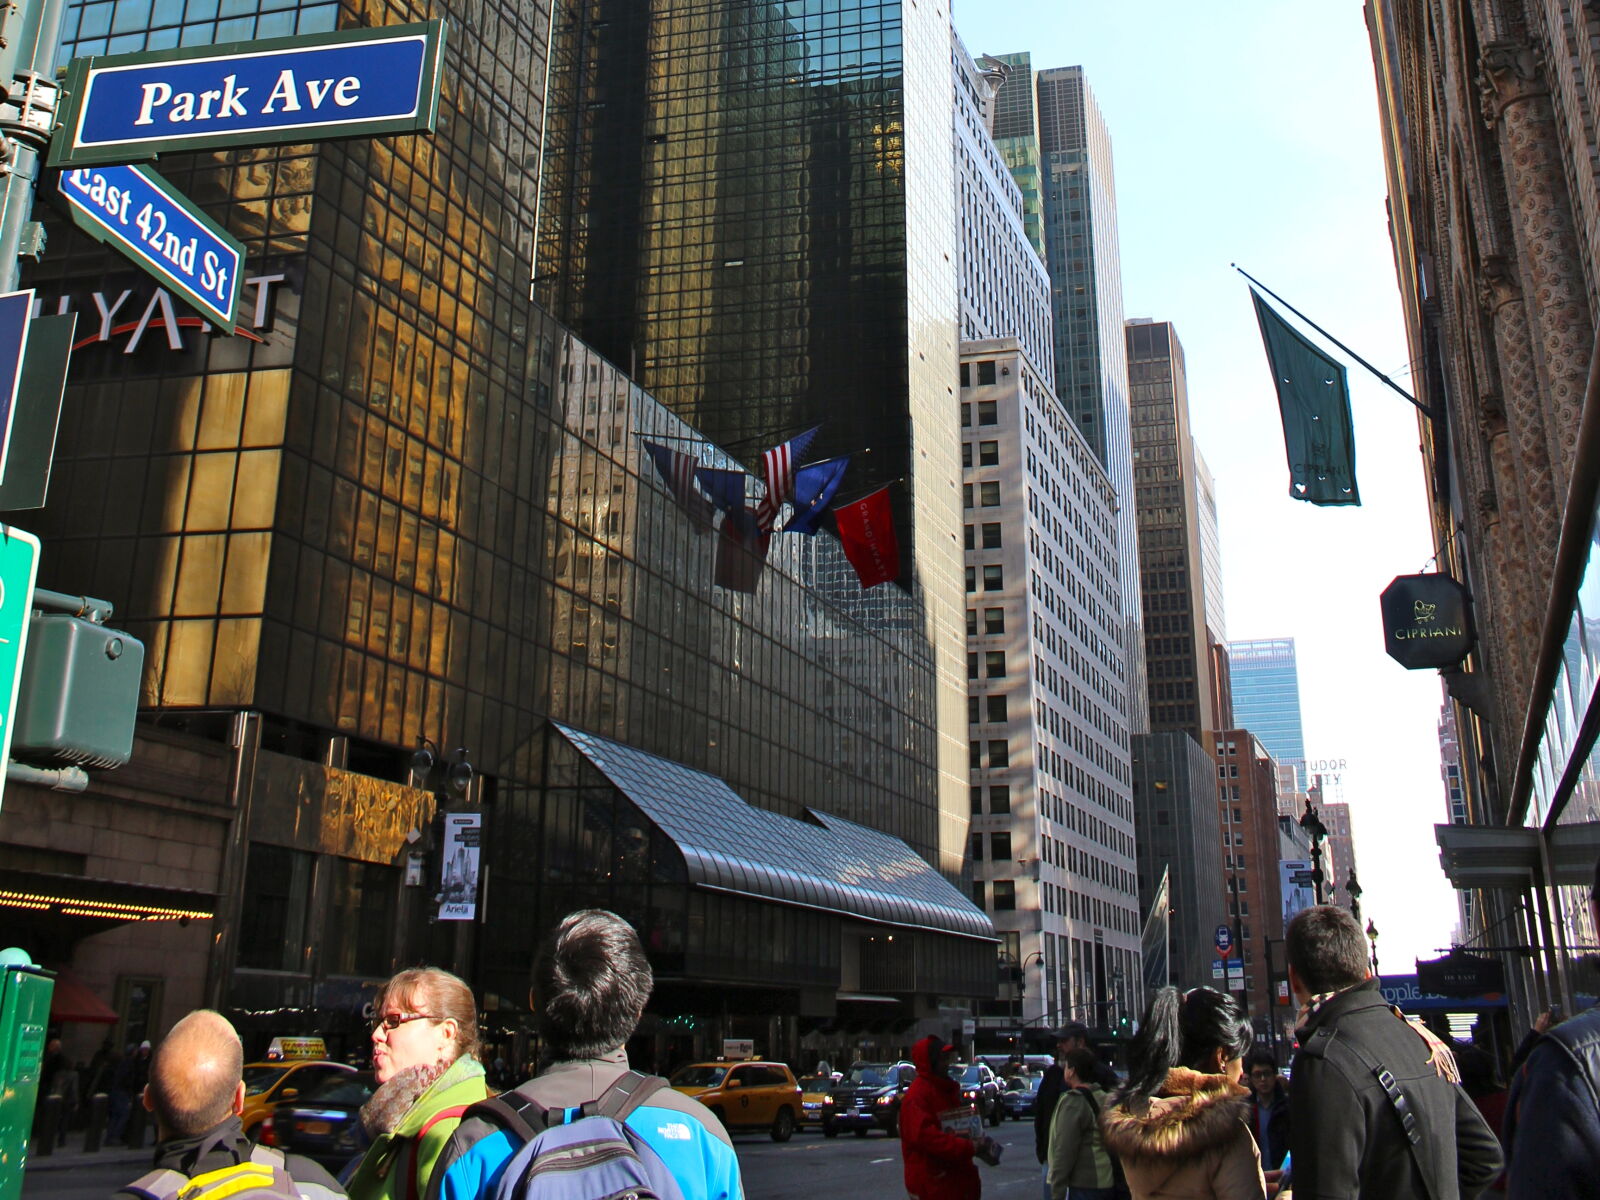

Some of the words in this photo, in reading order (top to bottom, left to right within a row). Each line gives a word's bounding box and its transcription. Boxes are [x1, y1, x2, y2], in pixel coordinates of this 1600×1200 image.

[134, 74, 249, 125] Park
[261, 69, 361, 114] Ave
[69, 169, 131, 225] East
[136, 202, 197, 276] 42nd
[200, 250, 228, 300] St
[31, 274, 285, 353] YAT
[1293, 463, 1347, 475] CIPRIANI
[1395, 626, 1462, 640] CIPRIANI
[1301, 758, 1347, 771] TUDOR
[1382, 982, 1422, 1005] pple
